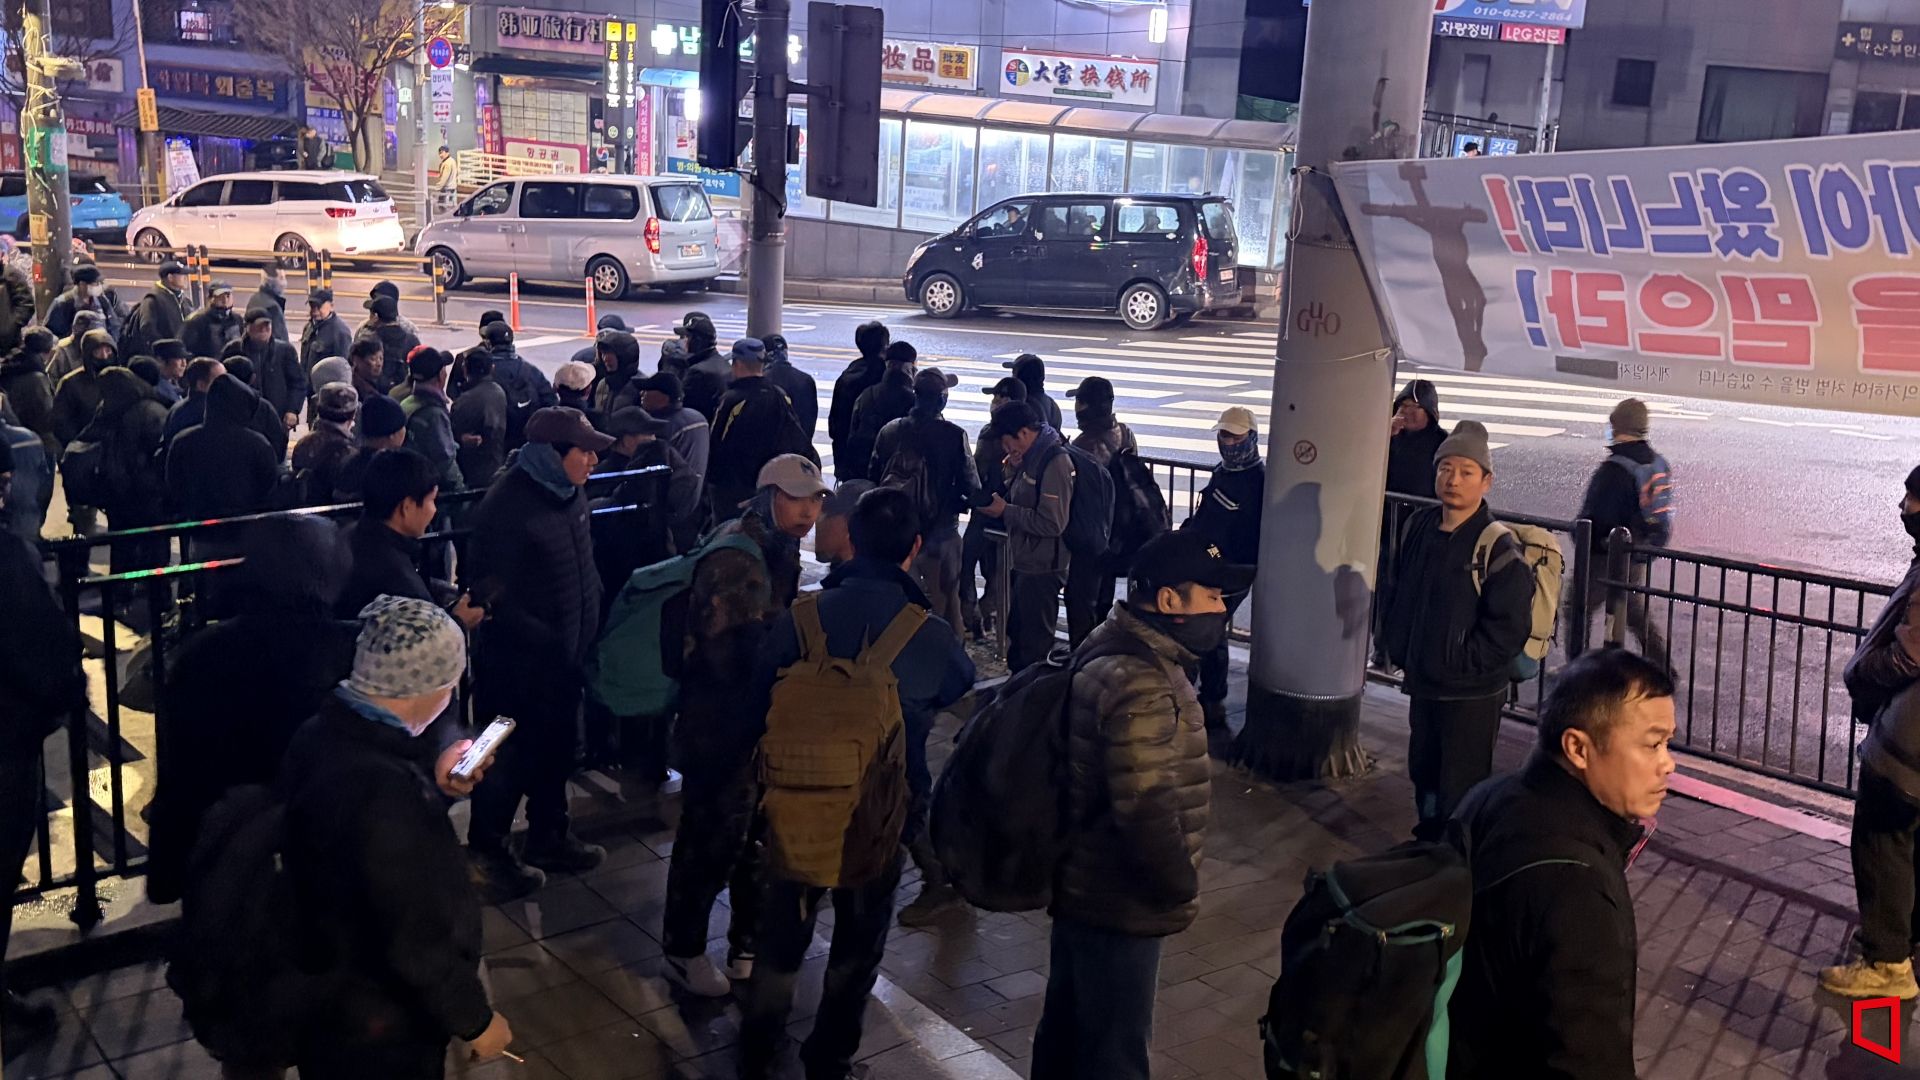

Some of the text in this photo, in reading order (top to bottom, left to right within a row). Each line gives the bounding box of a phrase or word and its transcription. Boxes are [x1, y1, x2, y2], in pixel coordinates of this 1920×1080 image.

[1440, 21, 1493, 39] 차량정비
[1505, 27, 1560, 43] LPG전문
[1032, 60, 1150, 93] 大宝换钱所
